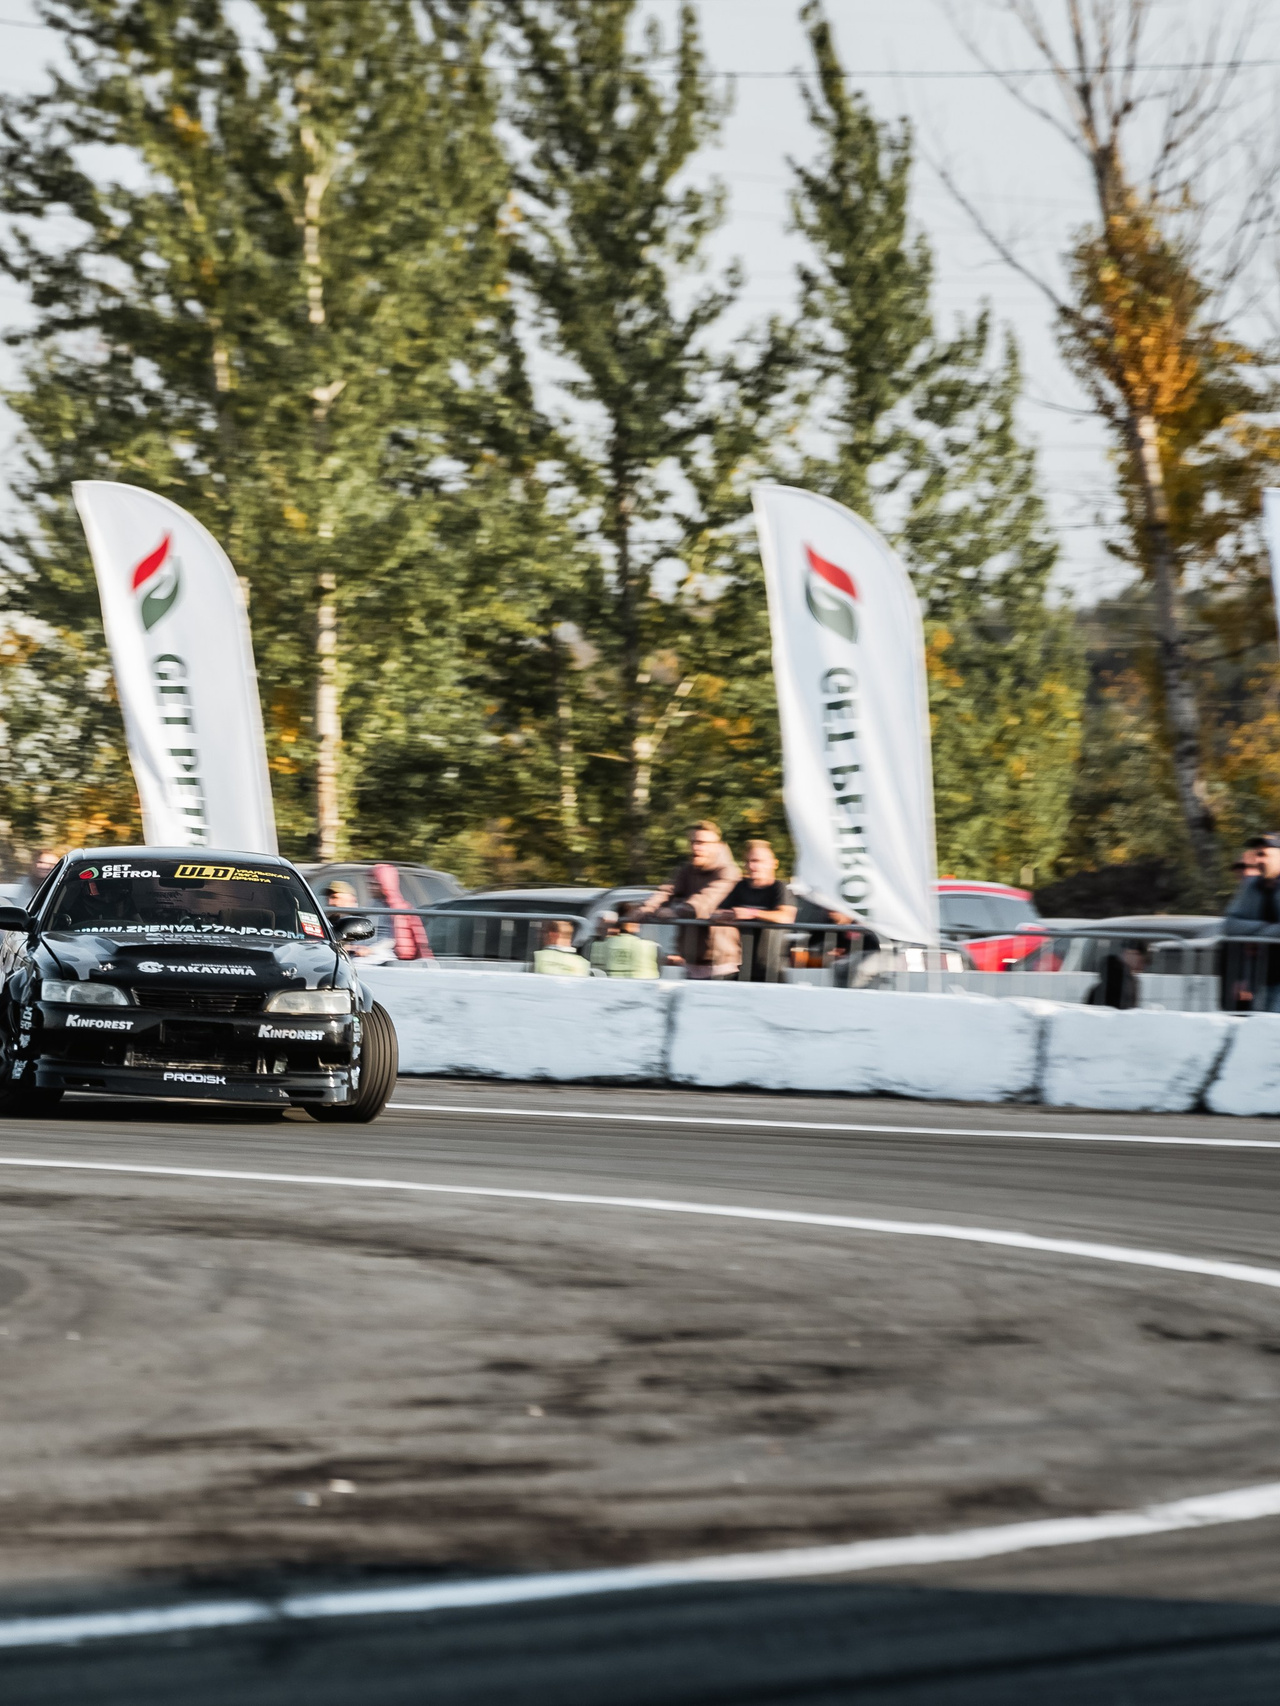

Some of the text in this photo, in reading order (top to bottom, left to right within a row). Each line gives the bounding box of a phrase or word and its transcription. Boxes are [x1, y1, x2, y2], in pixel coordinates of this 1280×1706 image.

[152, 653, 197, 734] GET
[167, 748, 211, 848] PETR
[101, 864, 132, 872] GET
[102, 870, 161, 879] PETROL
[178, 866, 231, 879] ULD
[166, 965, 257, 976] TAKAYAMA
[65, 1014, 134, 1030] KINFOREST
[258, 1024, 325, 1041] KINFOREST
